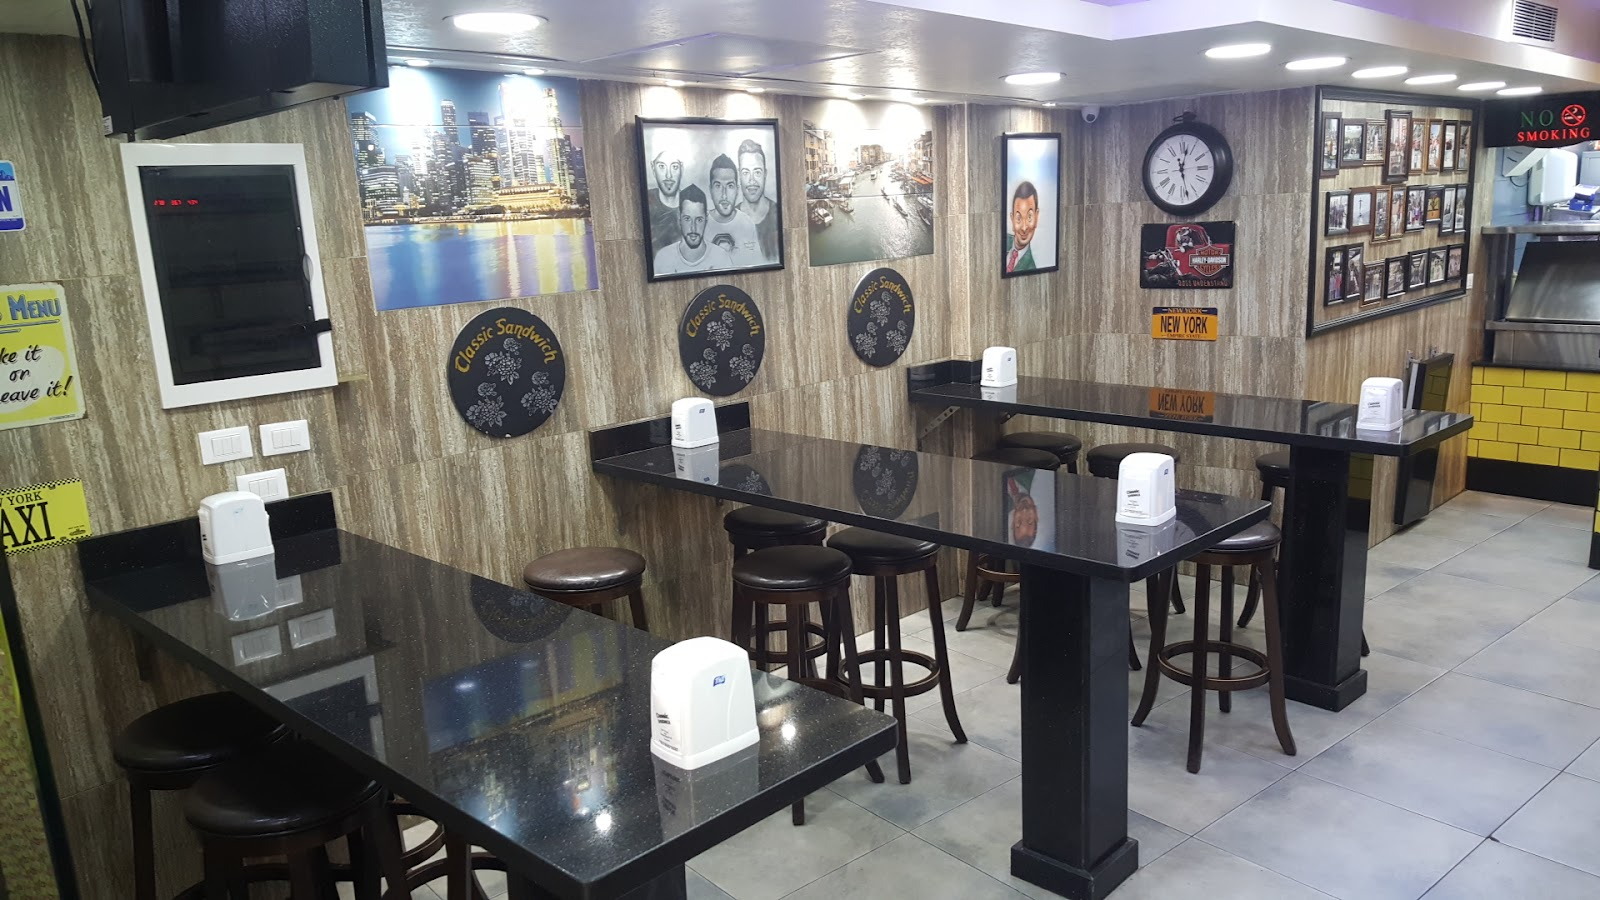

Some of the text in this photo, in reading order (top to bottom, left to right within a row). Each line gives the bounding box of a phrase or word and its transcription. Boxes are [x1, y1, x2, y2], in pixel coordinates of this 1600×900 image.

[1520, 109, 1554, 127] NO
[1517, 127, 1590, 142] SMOKING
[854, 276, 912, 315] Classic Sandwich
[7, 294, 62, 320] MENU
[686, 294, 760, 337] Classic Sandwich
[1160, 315, 1208, 334] NEW YORK
[25, 344, 42, 362] it
[454, 318, 558, 373] Classic Sandwich
[9, 369, 30, 382] or
[46, 375, 73, 397] it!
[6, 491, 43, 506] YORK
